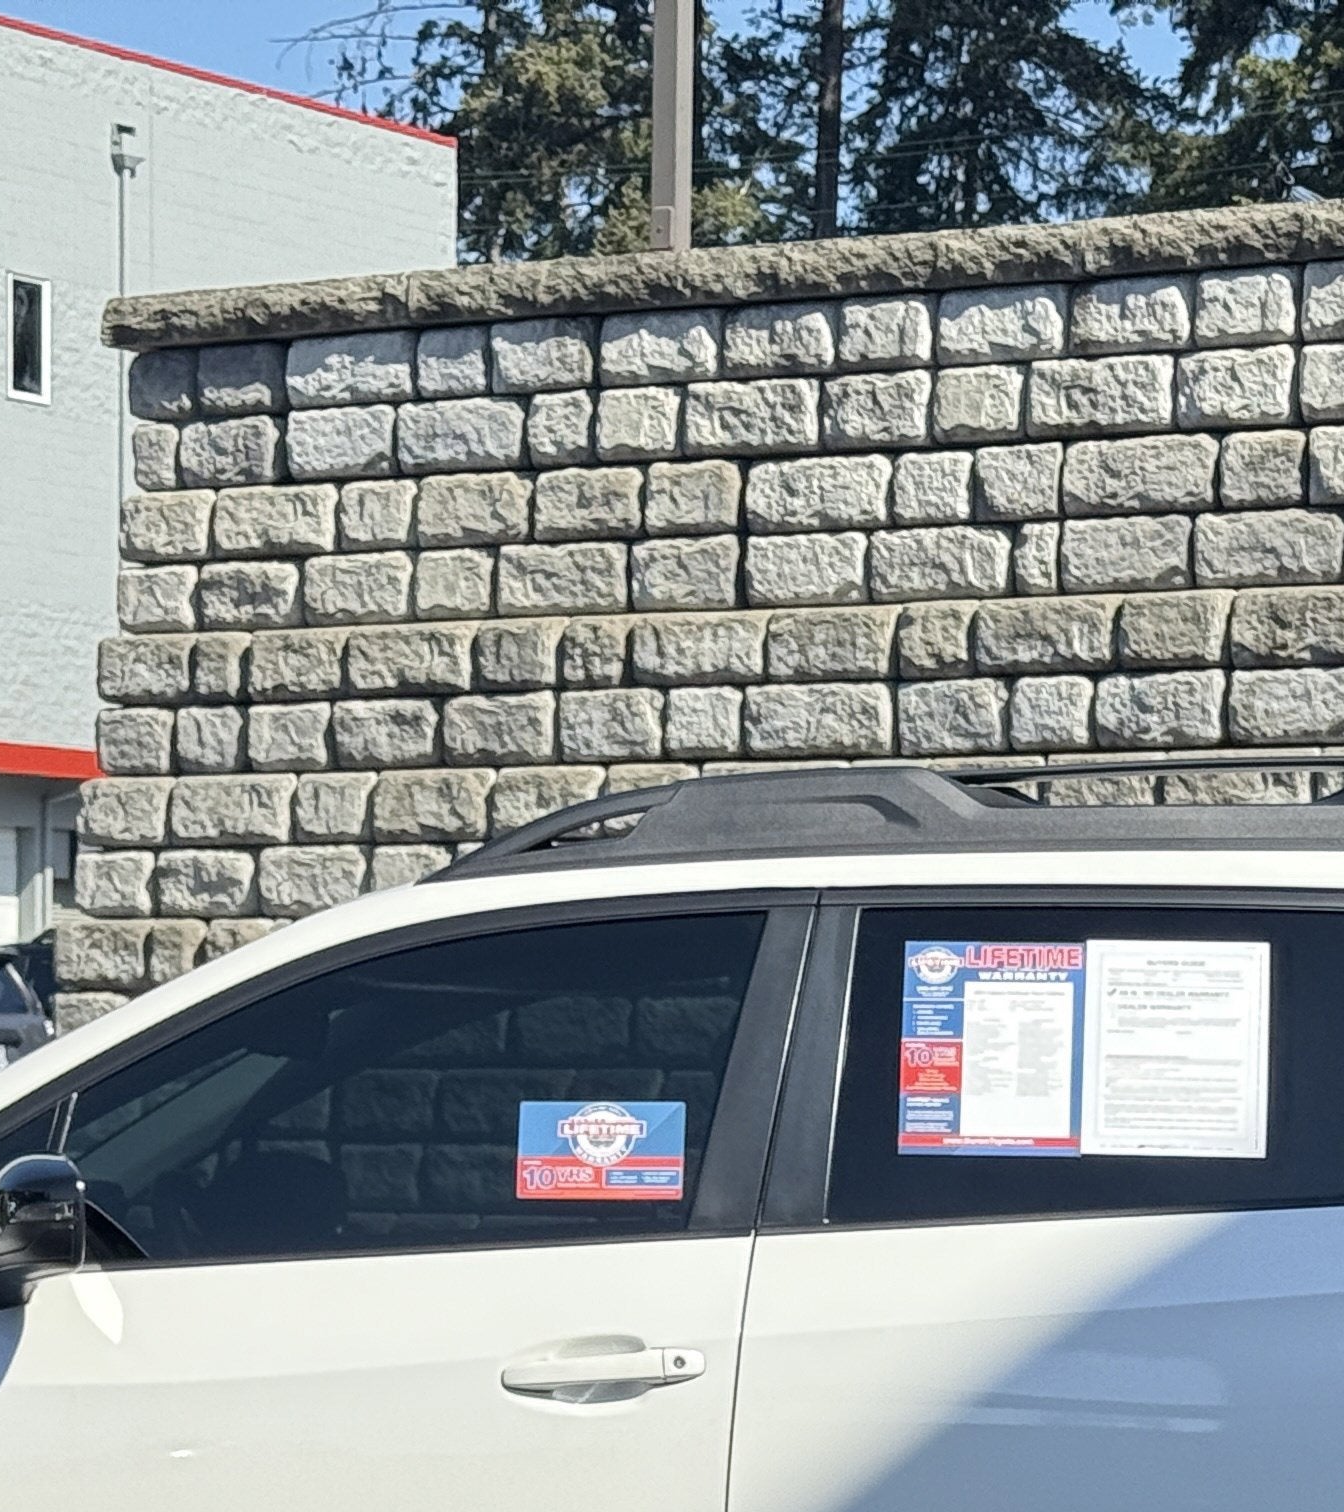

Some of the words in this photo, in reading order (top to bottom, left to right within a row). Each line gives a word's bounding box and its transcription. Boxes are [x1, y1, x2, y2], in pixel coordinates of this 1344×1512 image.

[966, 946, 1083, 970] LIFETIME
[978, 971, 1069, 981] WARRANTY
[906, 1047, 933, 1067] 10
[563, 1122, 641, 1136] LIFETIME
[523, 1167, 555, 1190] 10
[557, 1167, 593, 1184] YRS
